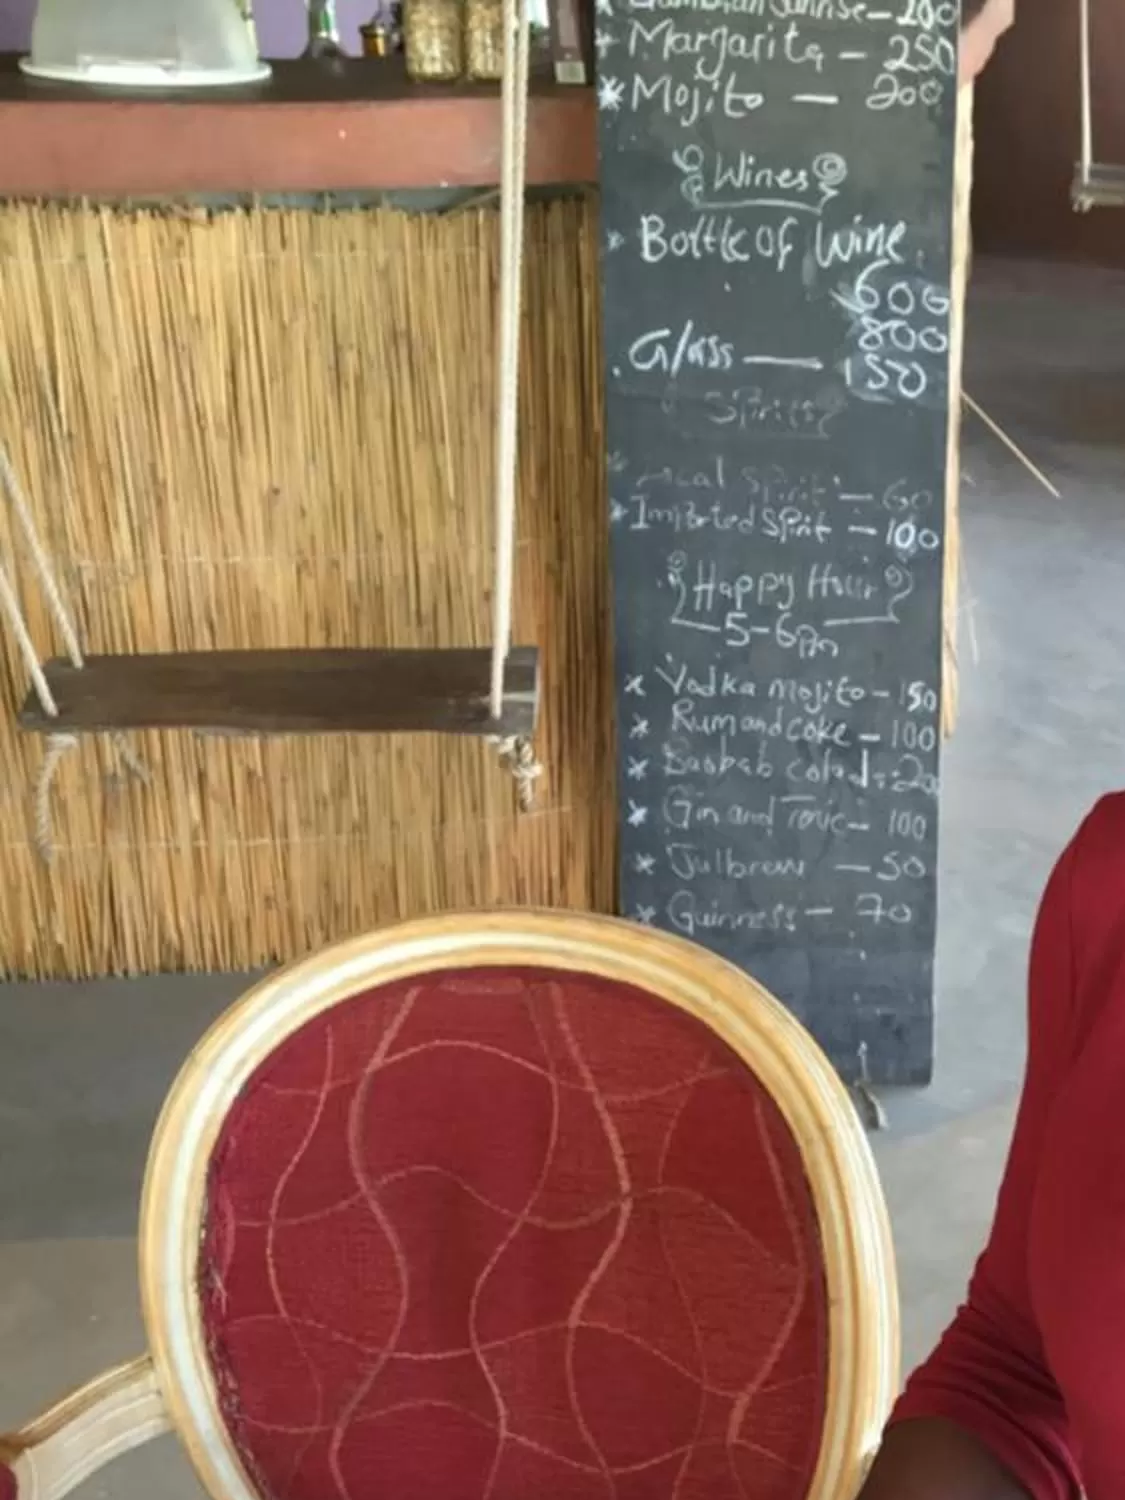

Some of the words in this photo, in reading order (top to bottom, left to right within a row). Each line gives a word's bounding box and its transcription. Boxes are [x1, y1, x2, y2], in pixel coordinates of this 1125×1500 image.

[883, 34, 954, 76] 250
[631, 71, 764, 127] Mojito
[865, 73, 943, 110] 200
[713, 150, 809, 192] Wines
[640, 214, 750, 263] Bottle
[858, 315, 949, 353] 800
[628, 319, 735, 378] Glass
[844, 352, 928, 398] 150
[885, 512, 940, 550] 100
[692, 558, 796, 612] Happy
[890, 718, 937, 752] 100
[887, 808, 928, 841] 100
[876, 851, 927, 882] 50
[855, 892, 913, 925] 70
